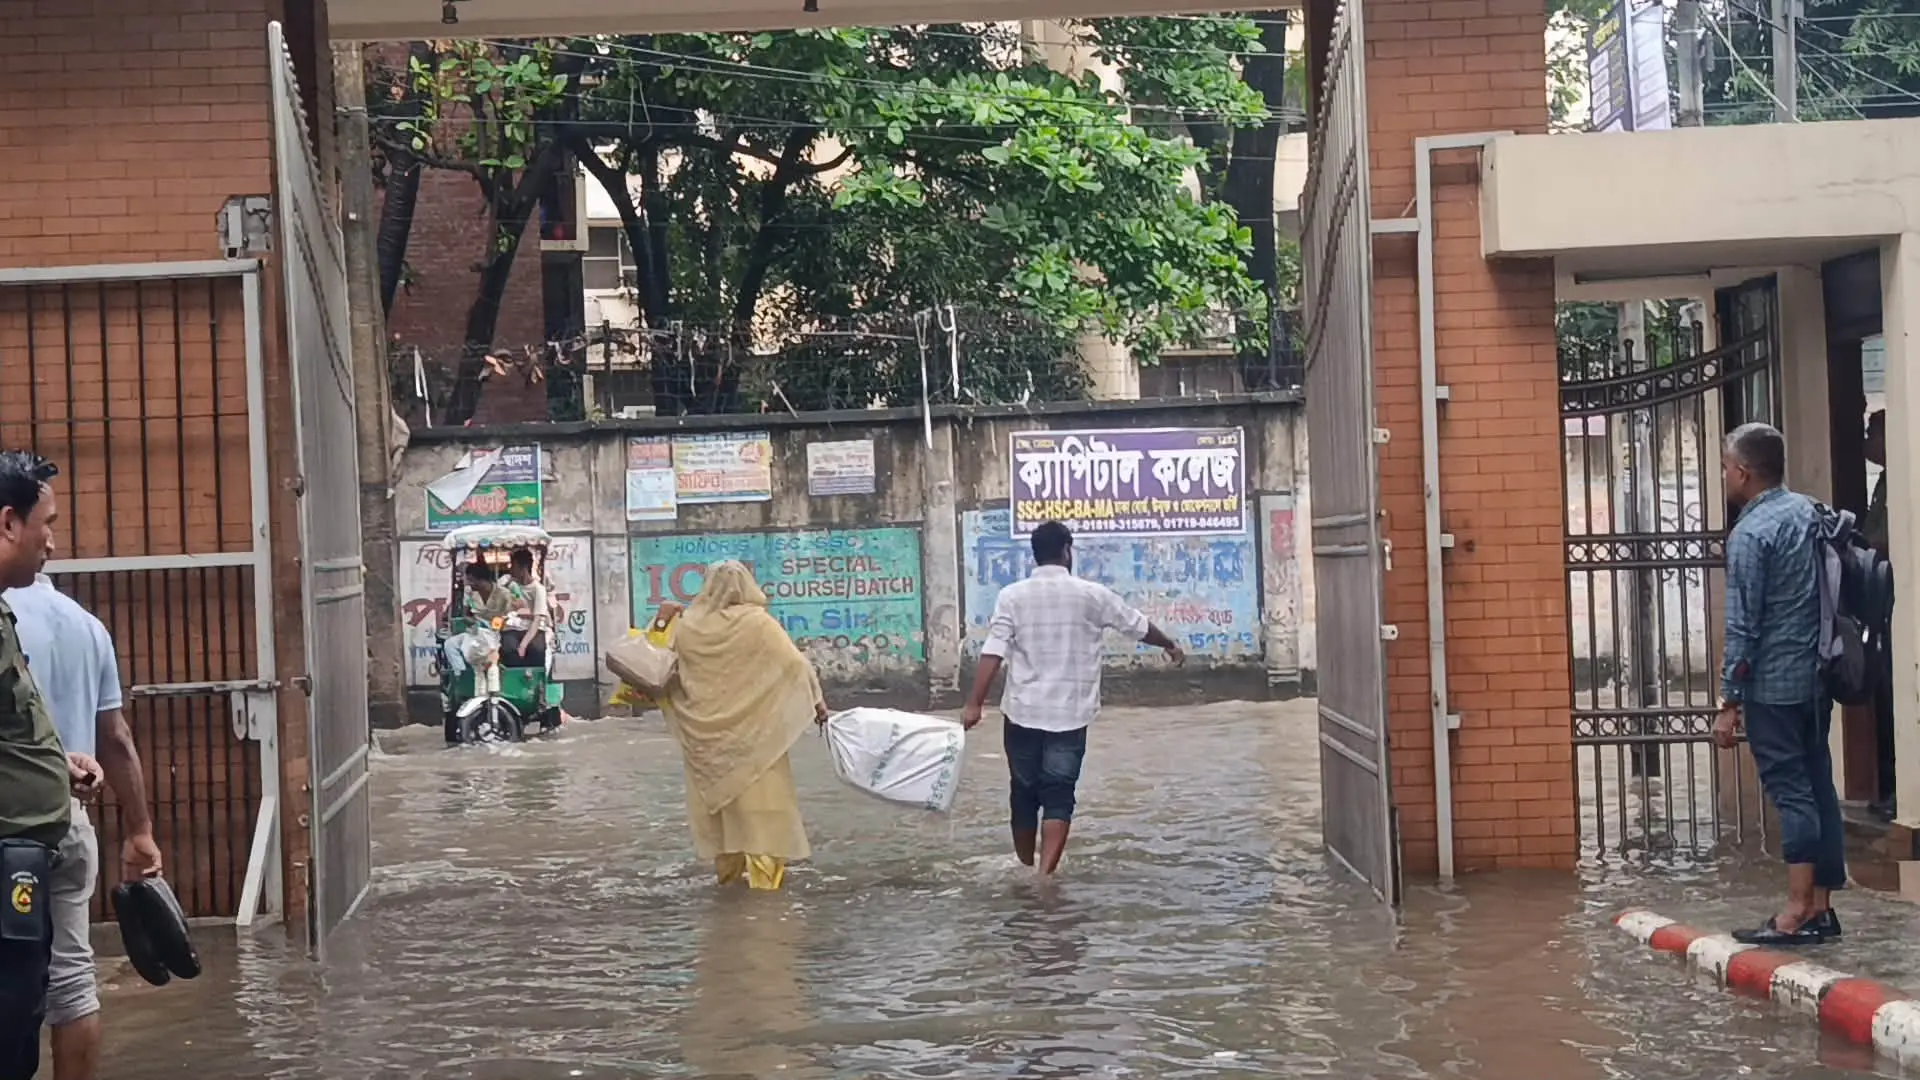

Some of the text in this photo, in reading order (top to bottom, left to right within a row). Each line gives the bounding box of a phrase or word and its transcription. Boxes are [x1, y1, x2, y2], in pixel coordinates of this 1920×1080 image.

[1015, 435, 1239, 499] ক্যাপিটাল কলেজ
[1017, 498, 1114, 520] SSC-HSC-BA-MA
[781, 555, 882, 575] SPECIAL
[761, 575, 914, 600] COURSE/BATCH
